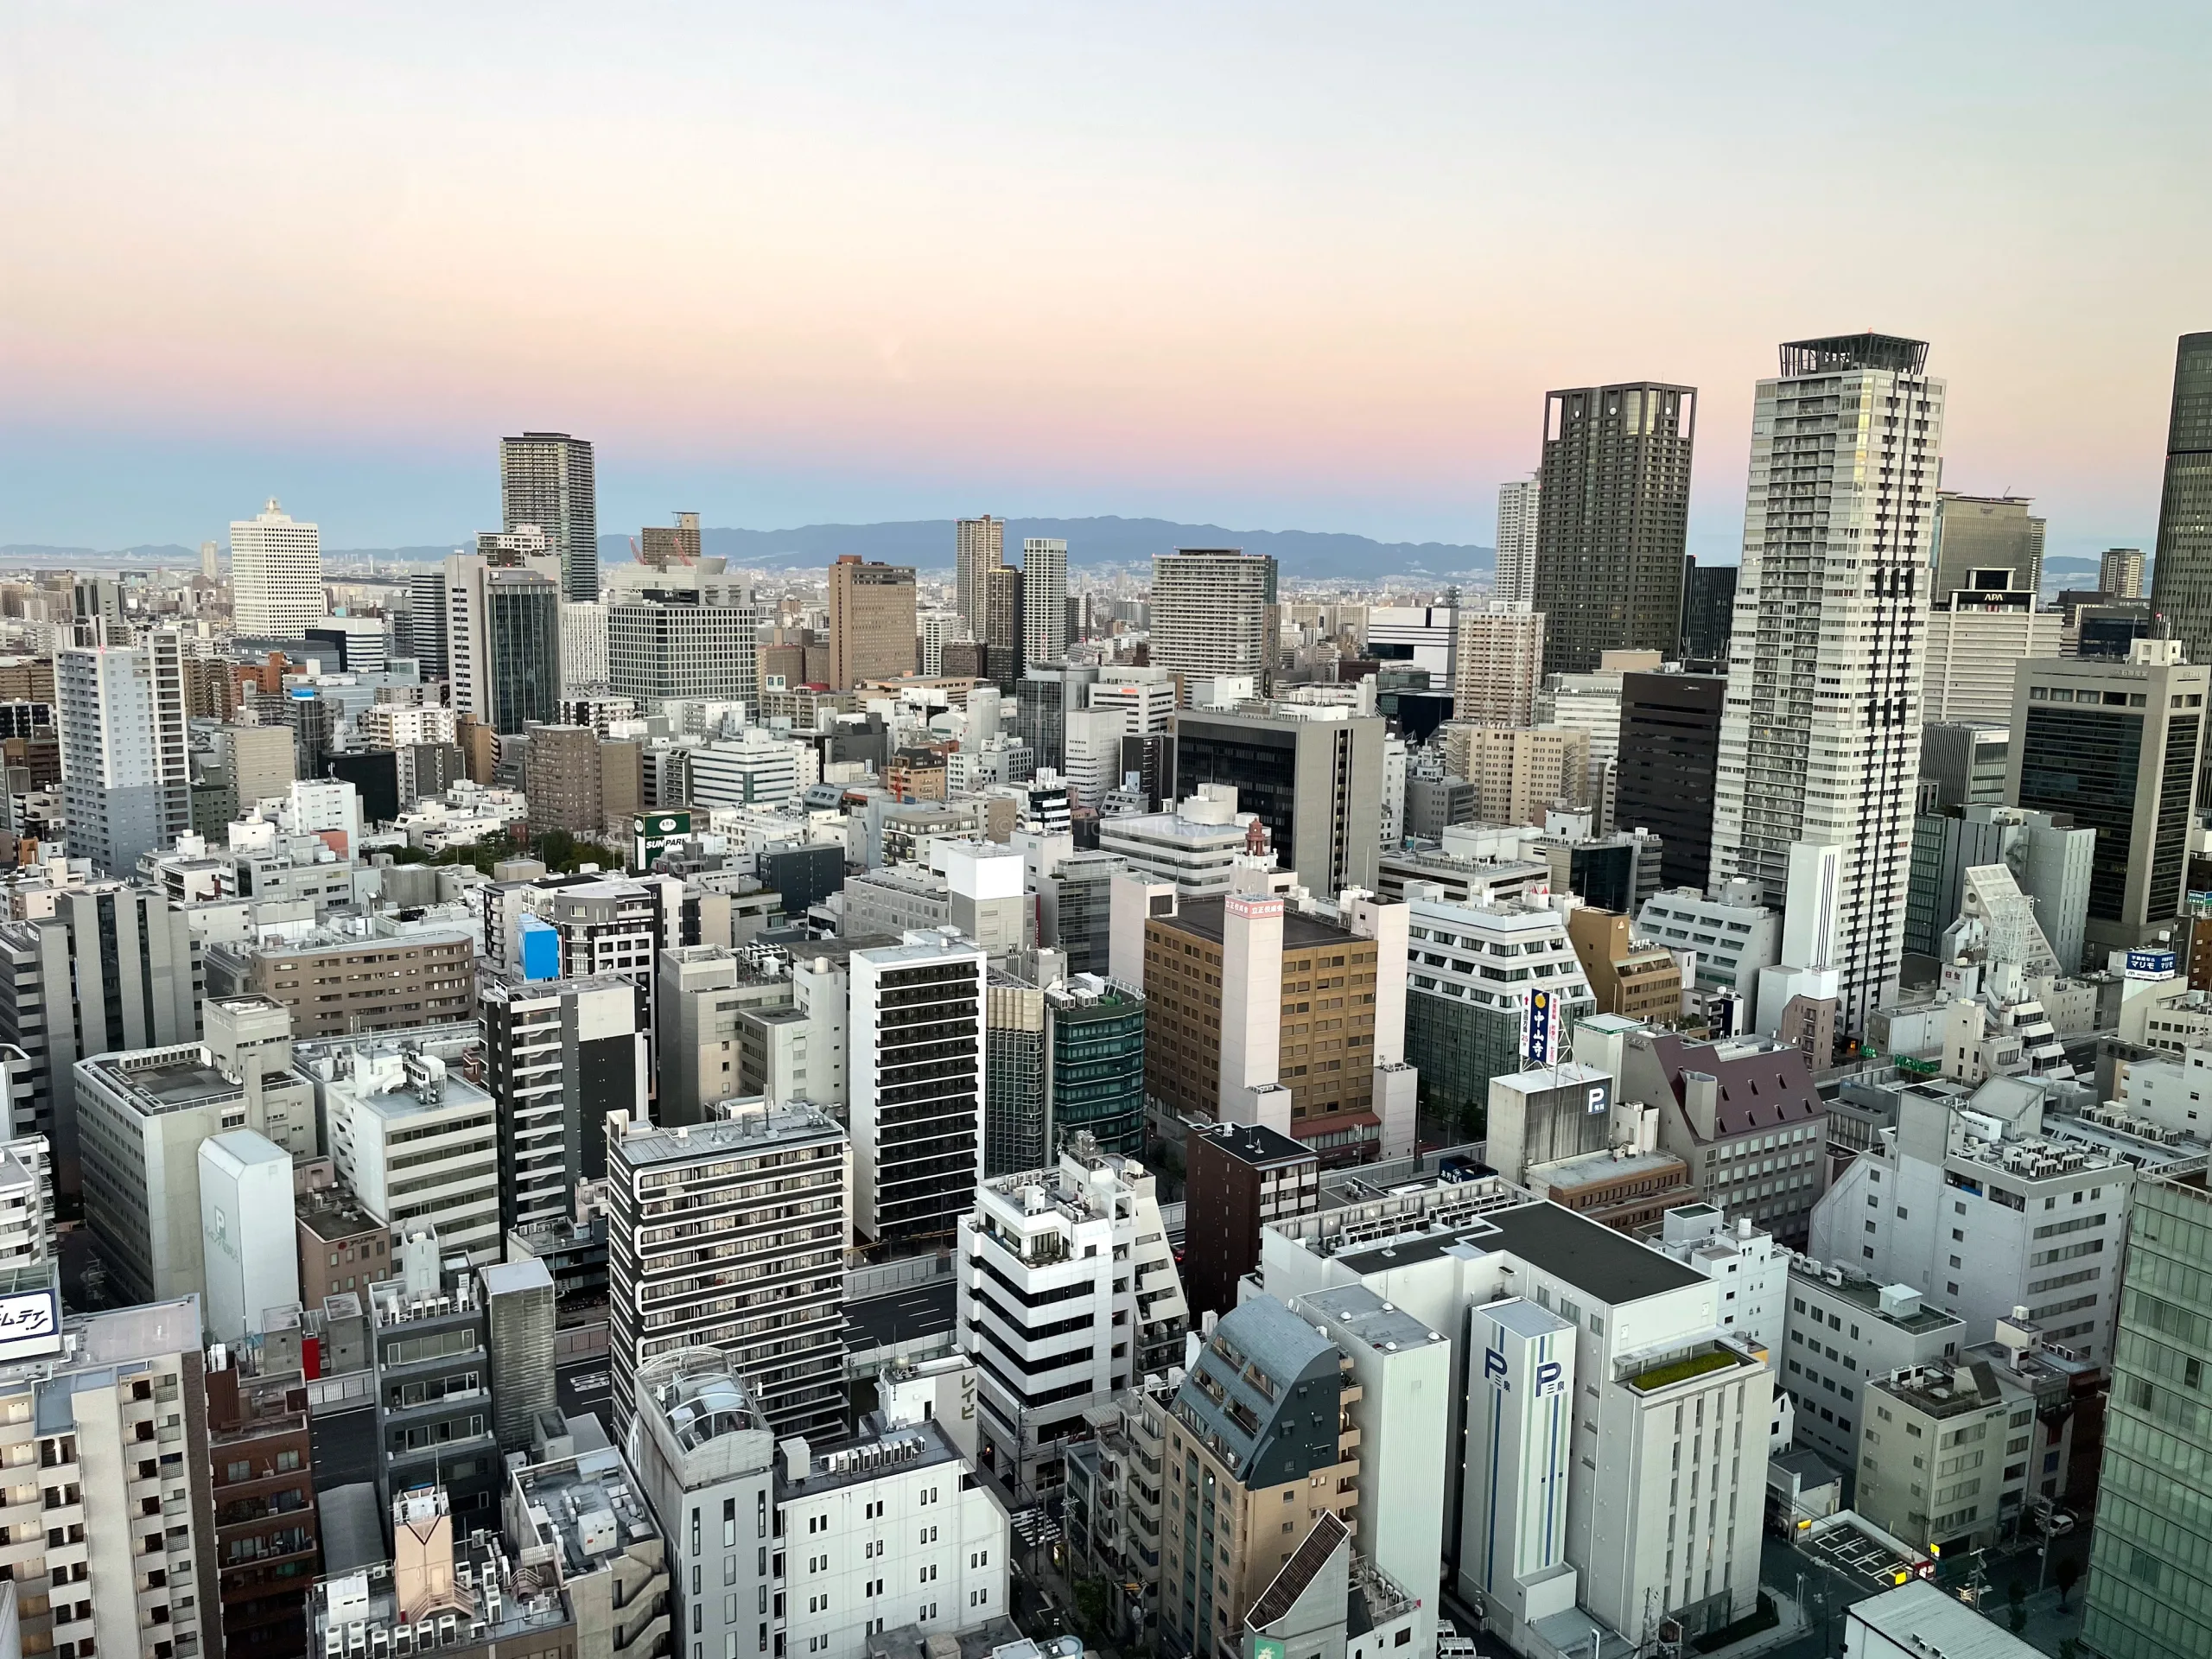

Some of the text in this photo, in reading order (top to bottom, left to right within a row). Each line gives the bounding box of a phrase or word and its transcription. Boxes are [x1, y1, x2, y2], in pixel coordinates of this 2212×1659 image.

[1984, 593, 2003, 601] APA
[645, 840, 664, 849] SUN
[2131, 961, 2155, 969] マリモ
[1532, 1010, 1545, 1058] 中山寺
[1587, 1088, 1604, 1113] P
[215, 1209, 226, 1234] P
[0, 1305, 48, 1331] ムティ
[1484, 1346, 1508, 1380] P
[1535, 1362, 1561, 1398] P
[961, 1375, 975, 1420] レイビ
